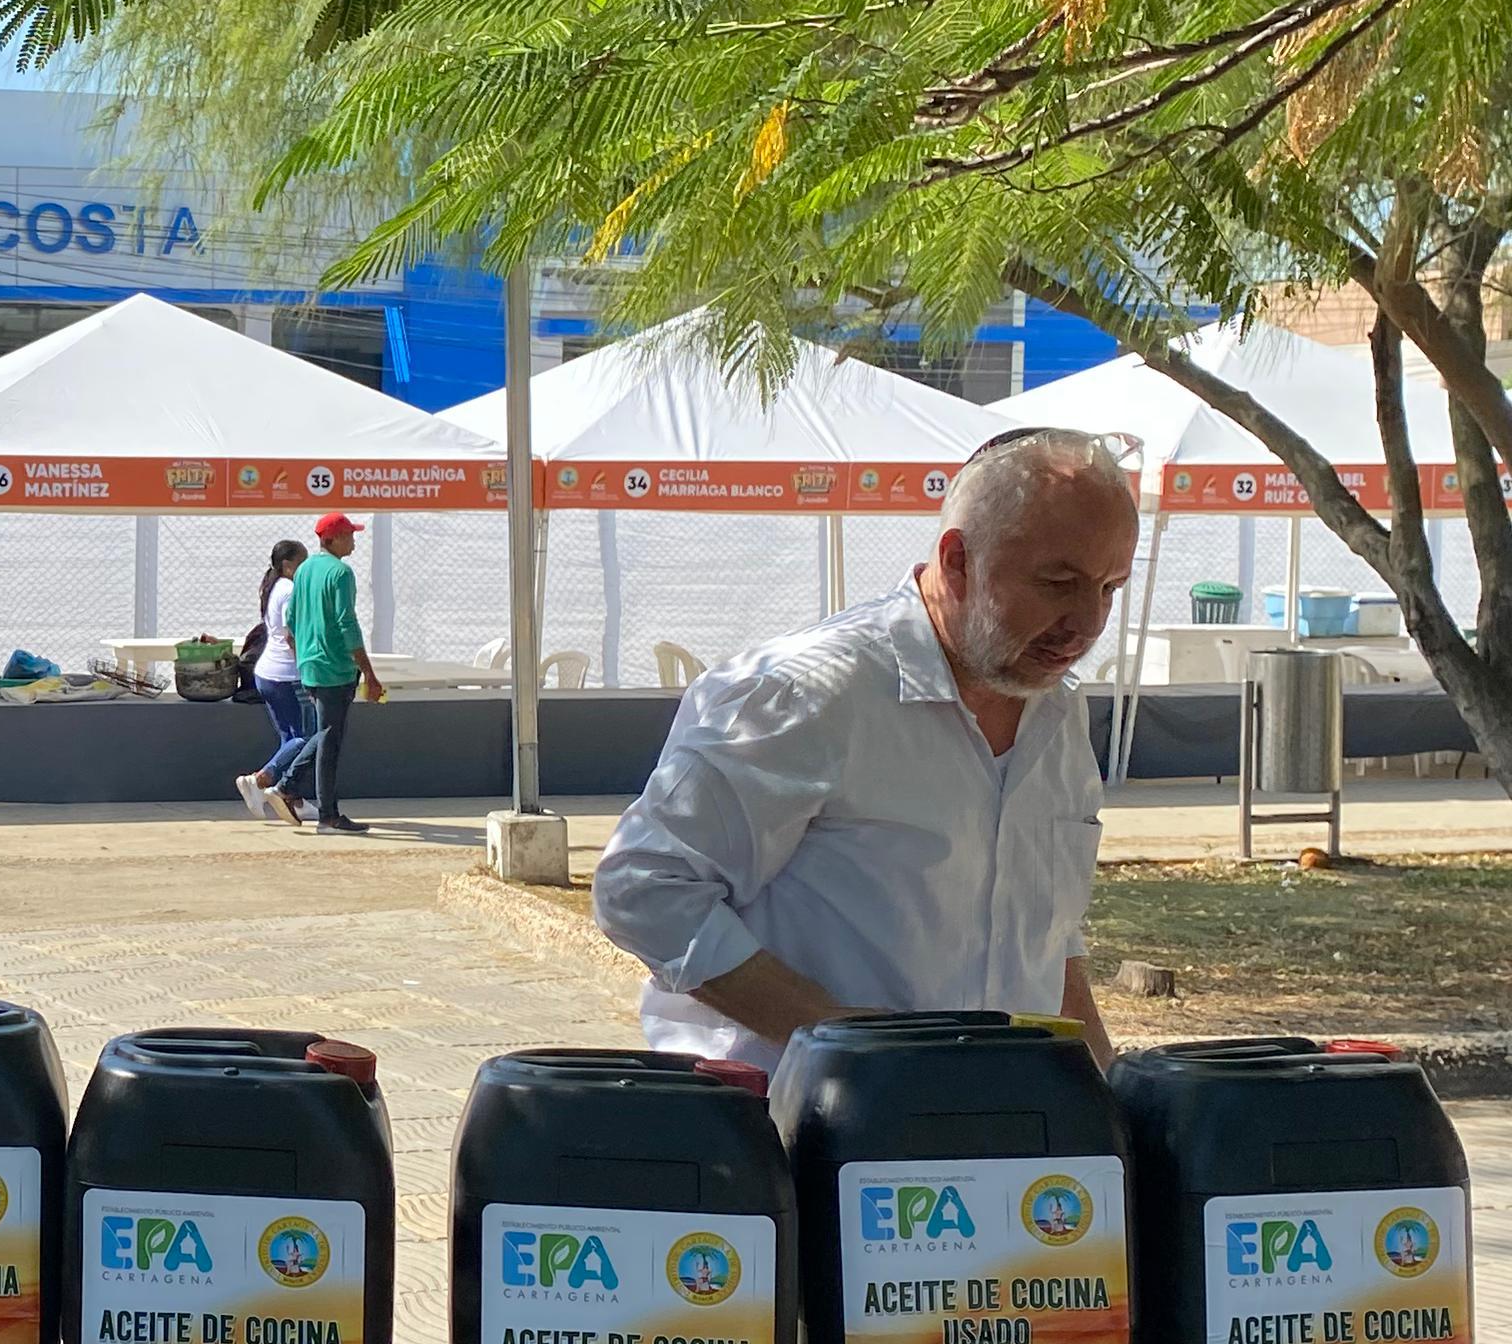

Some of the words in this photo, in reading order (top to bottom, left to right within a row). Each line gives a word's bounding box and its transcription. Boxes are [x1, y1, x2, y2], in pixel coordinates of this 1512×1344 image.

[24, 463, 103, 479] VANESSA
[343, 468, 408, 483] ROSALBA
[412, 465, 466, 482] ZUÑIGA
[660, 469, 709, 482] CECILIA
[25, 479, 110, 498] MARTÍNEZ
[311, 474, 330, 489] 35
[626, 476, 647, 490] 34
[926, 476, 946, 494] 33
[1236, 479, 1254, 496] 32
[343, 484, 441, 498] BLANQUICETT
[658, 484, 727, 497] MARRIAGA
[730, 484, 784, 497] BLANCO
[1264, 490, 1295, 503] RUÍZ
[860, 1185, 976, 1240] EPA
[101, 1216, 213, 1273] EPA
[864, 1241, 977, 1254] CARTAGENA
[1226, 1219, 1332, 1276] EPA
[502, 1231, 619, 1291] EPA
[102, 1270, 214, 1285] CARTAGENA
[1229, 1274, 1333, 1289] CARTAGENA
[503, 1288, 619, 1304] CARTAGENA
[864, 1279, 957, 1314] ACEITE
[967, 1279, 1001, 1311] DE
[1011, 1277, 1111, 1311] COCINA
[98, 1309, 192, 1344] ACEITE
[1323, 1310, 1355, 1344] DE
[1364, 1307, 1454, 1342] COCINA
